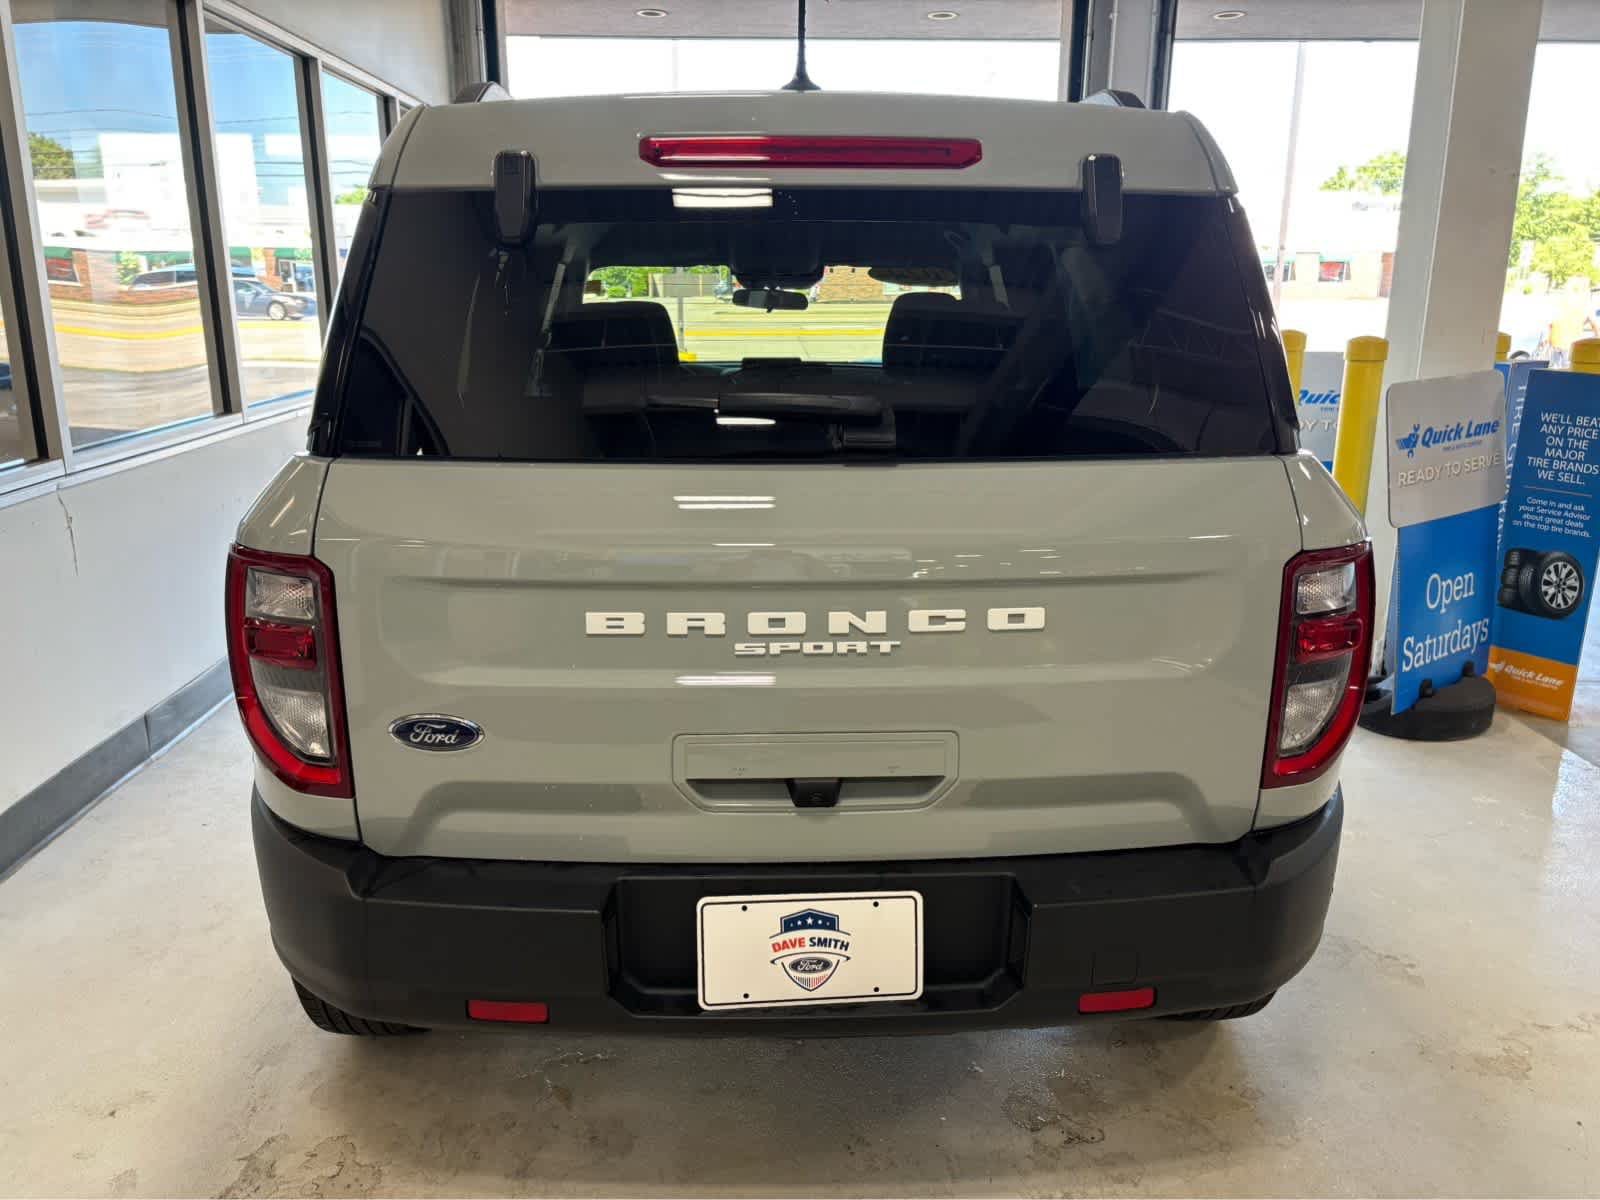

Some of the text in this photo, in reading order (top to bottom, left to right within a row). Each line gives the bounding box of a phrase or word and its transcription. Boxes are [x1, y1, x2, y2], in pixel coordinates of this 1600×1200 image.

[1299, 388, 1341, 406] Quic
[1541, 411, 1572, 425] WE'LL
[1422, 422, 1464, 448] Quick
[1465, 420, 1500, 438] Lane
[1540, 423, 1599, 440] ANY PRICE
[1545, 436, 1589, 450] ON THE
[1545, 447, 1585, 461] MAJOR
[1398, 453, 1501, 488] READY TO SERVE
[1528, 456, 1599, 475] TIRE BRANDS
[1537, 469, 1585, 485] WE SELL.
[1526, 496, 1585, 511] Come in and ask
[1519, 504, 1591, 521] your Service Advisor
[1522, 513, 1584, 529] about great deals
[1523, 520, 1536, 529] the
[1537, 522, 1550, 532] top
[1551, 525, 1563, 534] tire
[1426, 572, 1475, 614] Open
[585, 606, 1046, 636] BRONCO
[734, 640, 901, 656] SPORT
[1402, 618, 1490, 673] Saturdays
[409, 722, 460, 744] Ford
[771, 936, 850, 953] DAVE SMITH
[797, 959, 824, 971] Ford
